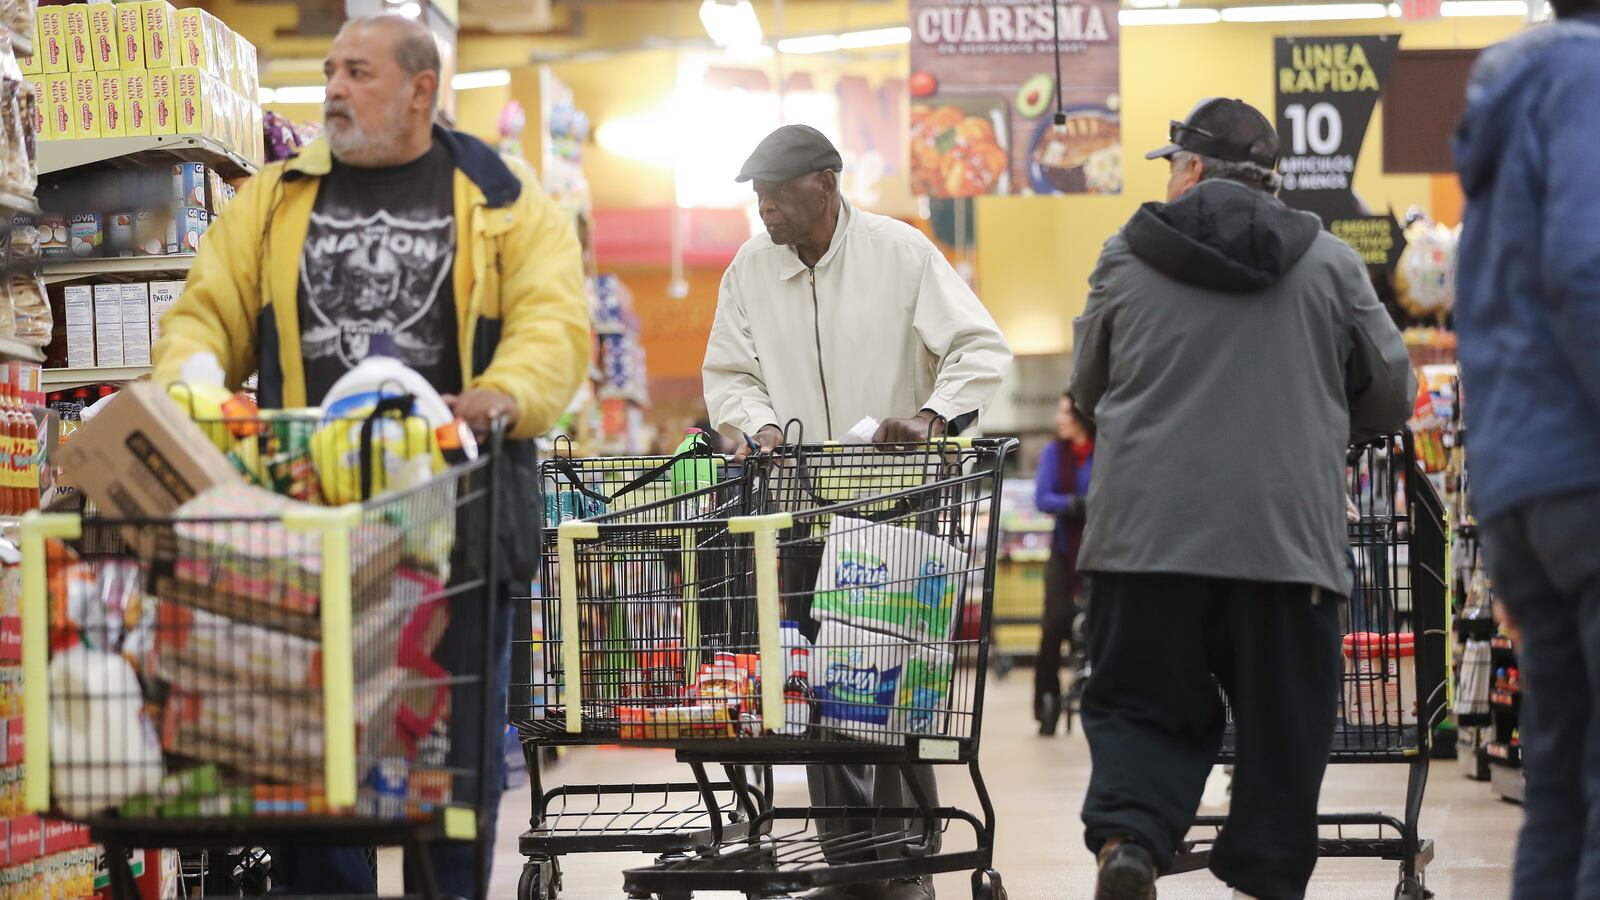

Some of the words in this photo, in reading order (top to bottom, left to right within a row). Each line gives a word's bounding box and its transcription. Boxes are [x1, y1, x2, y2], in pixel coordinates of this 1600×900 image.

[916, 6, 1109, 43] CUARESMA
[1292, 43, 1371, 70] LINEA
[1279, 66, 1380, 93] RAPIDA
[1284, 102, 1342, 154] 10
[1279, 154, 1354, 173] ARTICULOS
[1298, 172, 1348, 190] MENOS
[312, 231, 438, 261] NATION
